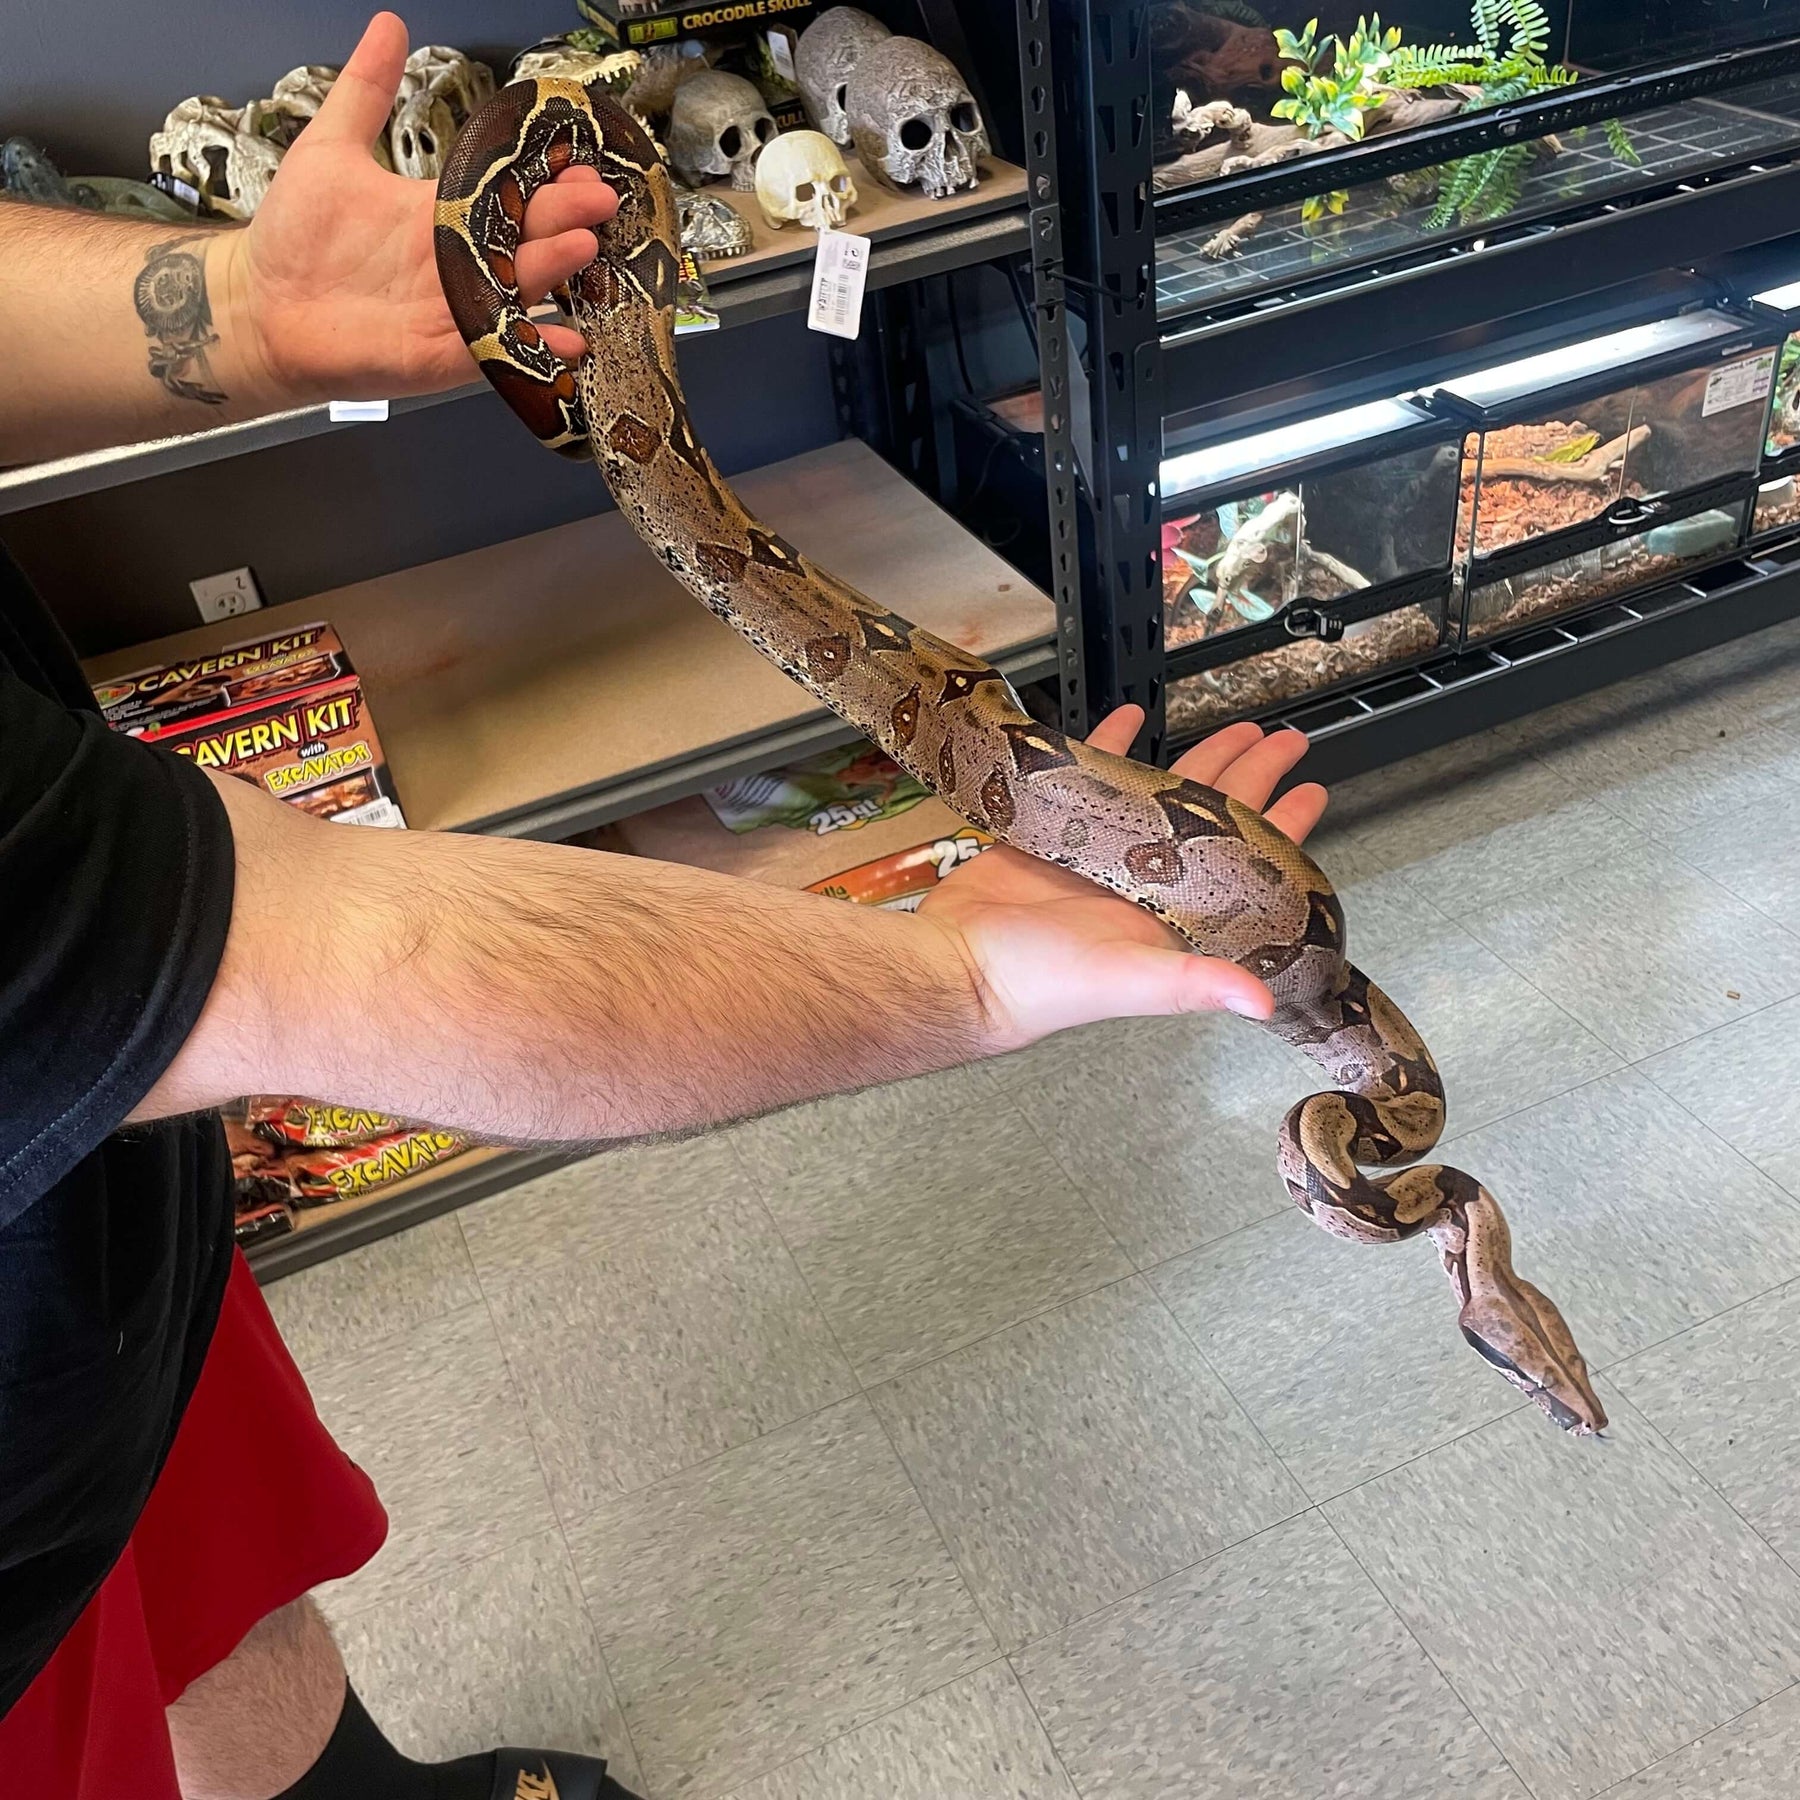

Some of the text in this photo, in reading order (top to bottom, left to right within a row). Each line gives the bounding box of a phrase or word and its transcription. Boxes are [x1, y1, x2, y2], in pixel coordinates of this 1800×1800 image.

[682, 0, 812, 29] CROCODILE SKULL
[138, 631, 315, 692] CAVERN KIT
[306, 697, 353, 738] KIT
[266, 742, 371, 793] EXCAVATOR
[301, 741, 326, 758] with
[933, 838, 993, 878] 25
[328, 1131, 464, 1192] EXCAVATO
